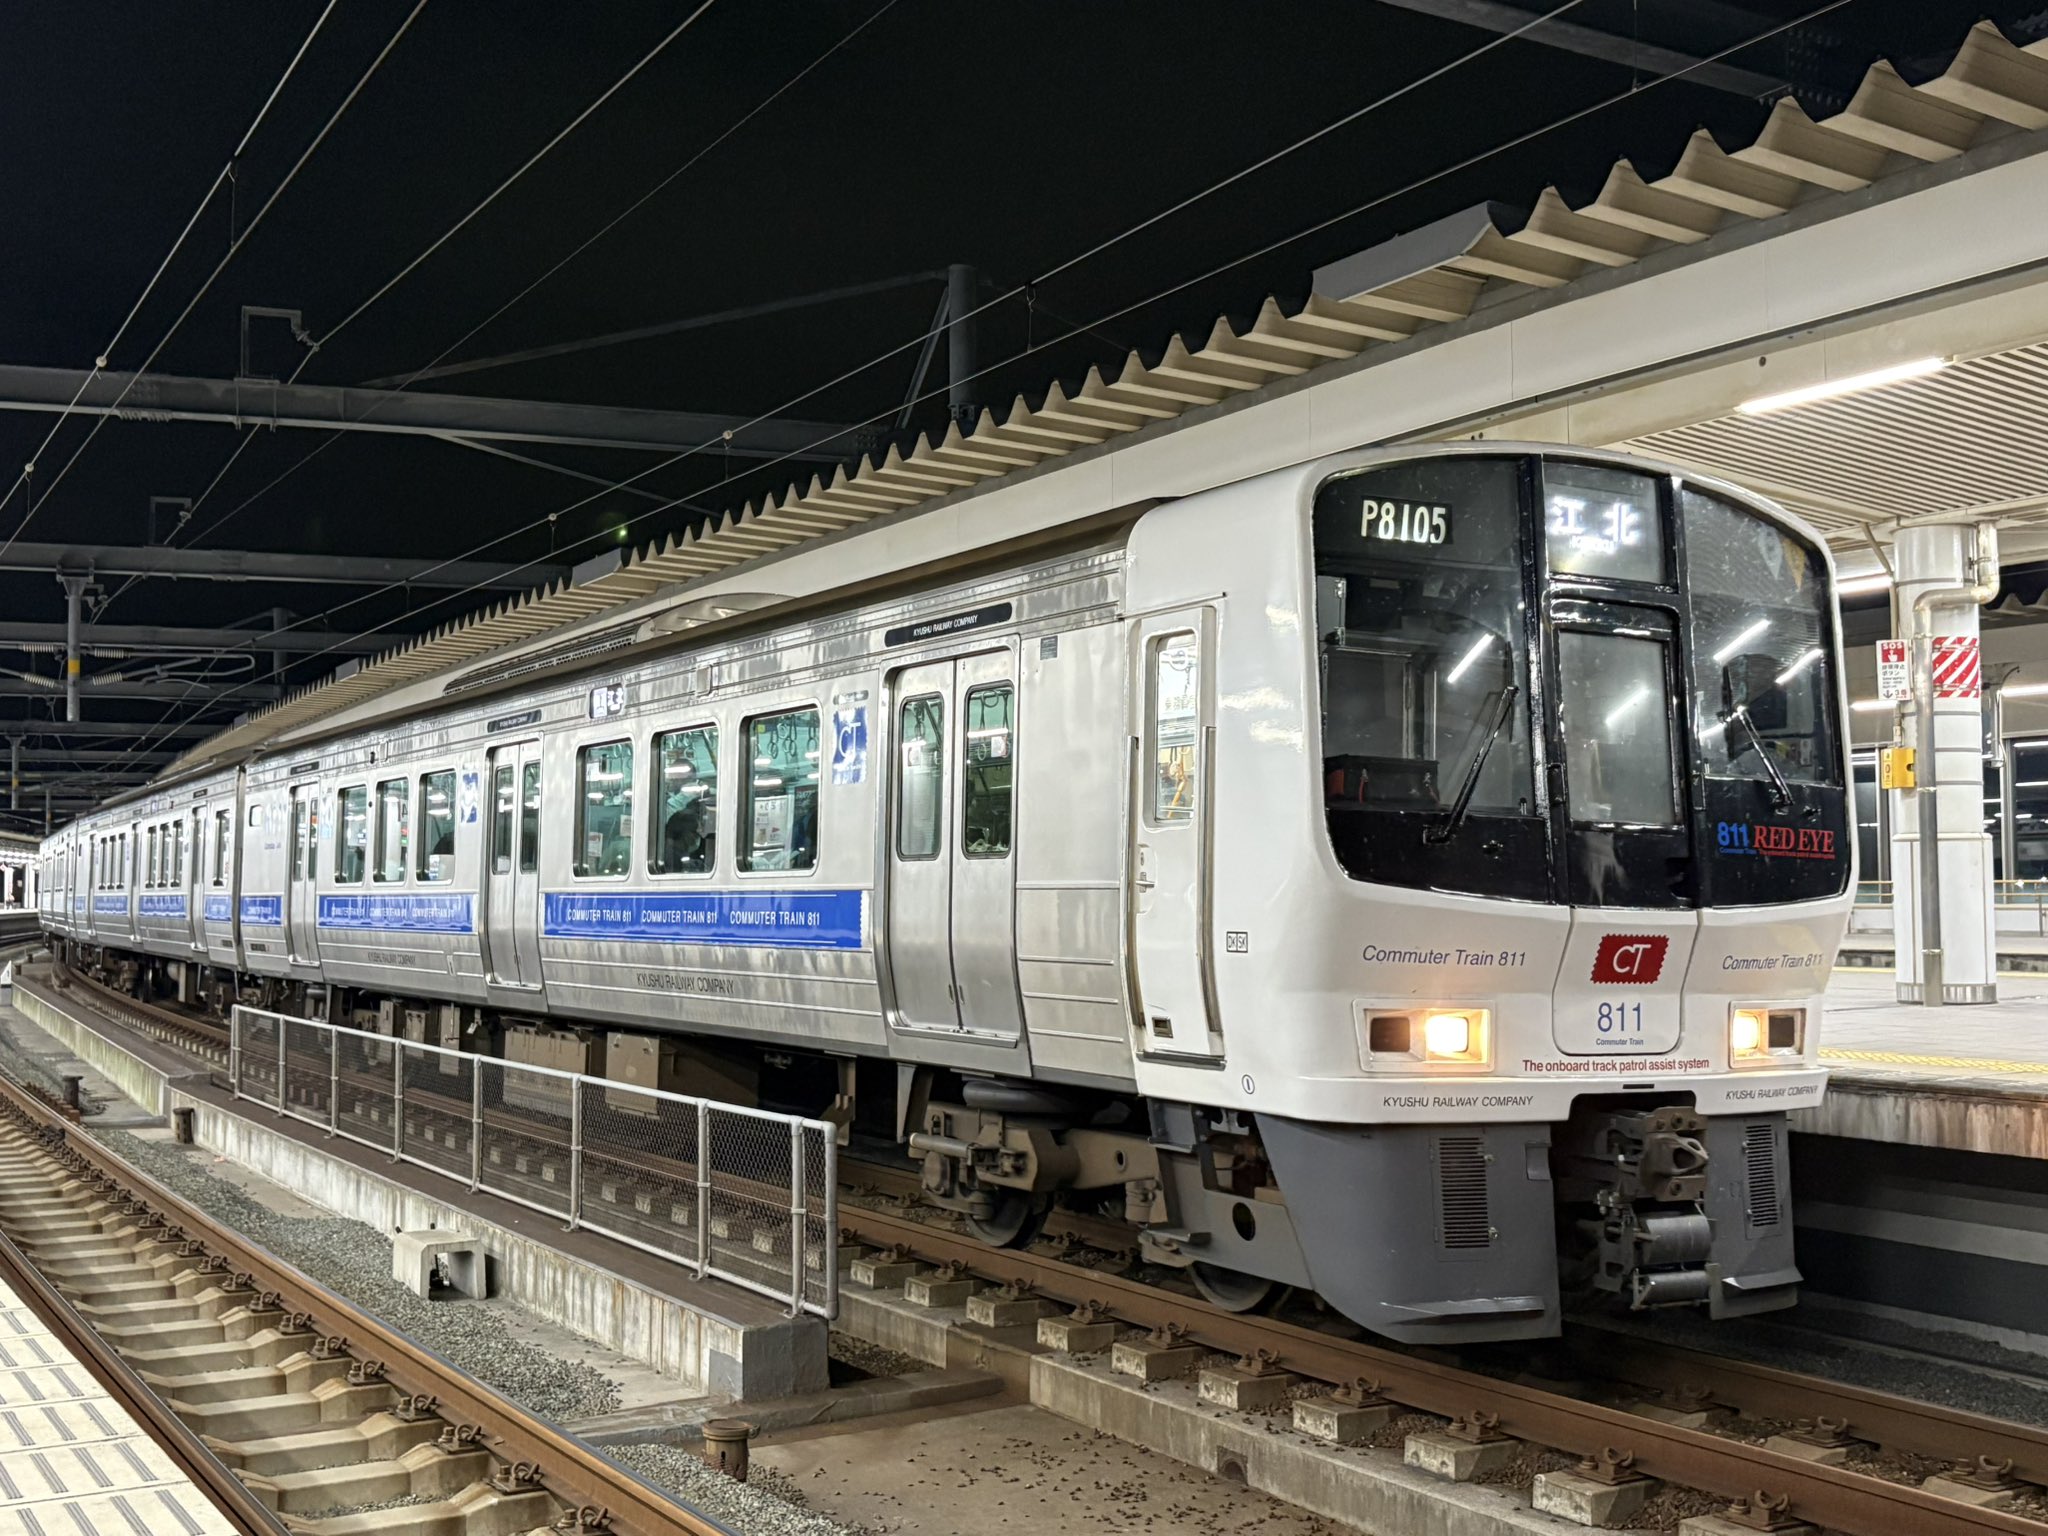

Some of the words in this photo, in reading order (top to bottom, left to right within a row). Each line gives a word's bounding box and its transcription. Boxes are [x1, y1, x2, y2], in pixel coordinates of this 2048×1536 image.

[1361, 500, 1446, 544] P8105
[913, 625, 932, 637] KYUSHU
[932, 620, 953, 633] RAILWAY
[953, 614, 979, 628] COMPANY
[1882, 642, 1903, 650] SOS
[1717, 821, 1750, 847] 811
[1753, 825, 1795, 850] RED
[1798, 828, 1835, 853] EYE
[567, 909, 600, 921] COMMUTER
[603, 909, 620, 922] TRAIN
[622, 910, 632, 922] 811
[642, 910, 681, 923] COMMUTER
[683, 910, 705, 923] TRAIN
[706, 911, 717, 924] 811
[730, 910, 776, 925] COMMUTER
[779, 911, 805, 925] TRAIN
[807, 912, 820, 926] 811
[1362, 944, 1450, 965] Commuter
[1455, 949, 1494, 966] Train
[1498, 951, 1526, 967] 811
[1612, 943, 1652, 975] CT
[1722, 955, 1780, 970] Commuter
[1780, 954, 1804, 968] Train
[1804, 953, 1822, 968] 811
[637, 973, 664, 988] KYUSHU
[665, 974, 695, 990] RAILWAY
[697, 976, 734, 994] COMPANY
[1597, 1002, 1641, 1032] 811
[1595, 1038, 1628, 1046] Commuter
[1629, 1037, 1644, 1046] Train
[1522, 1059, 1544, 1072] The
[1545, 1059, 1590, 1072] onboard
[1592, 1060, 1618, 1072] track
[1619, 1059, 1647, 1074] patrol
[1649, 1058, 1676, 1071] assist
[1678, 1059, 1710, 1073] system
[1725, 1090, 1756, 1100] KYUSHU
[1757, 1087, 1787, 1099] RAILWAY
[1787, 1085, 1819, 1096] COMPANY
[1383, 1096, 1429, 1107] KYUSHU
[1432, 1096, 1479, 1107] RAILWAY
[1481, 1095, 1534, 1107] COMPANY
